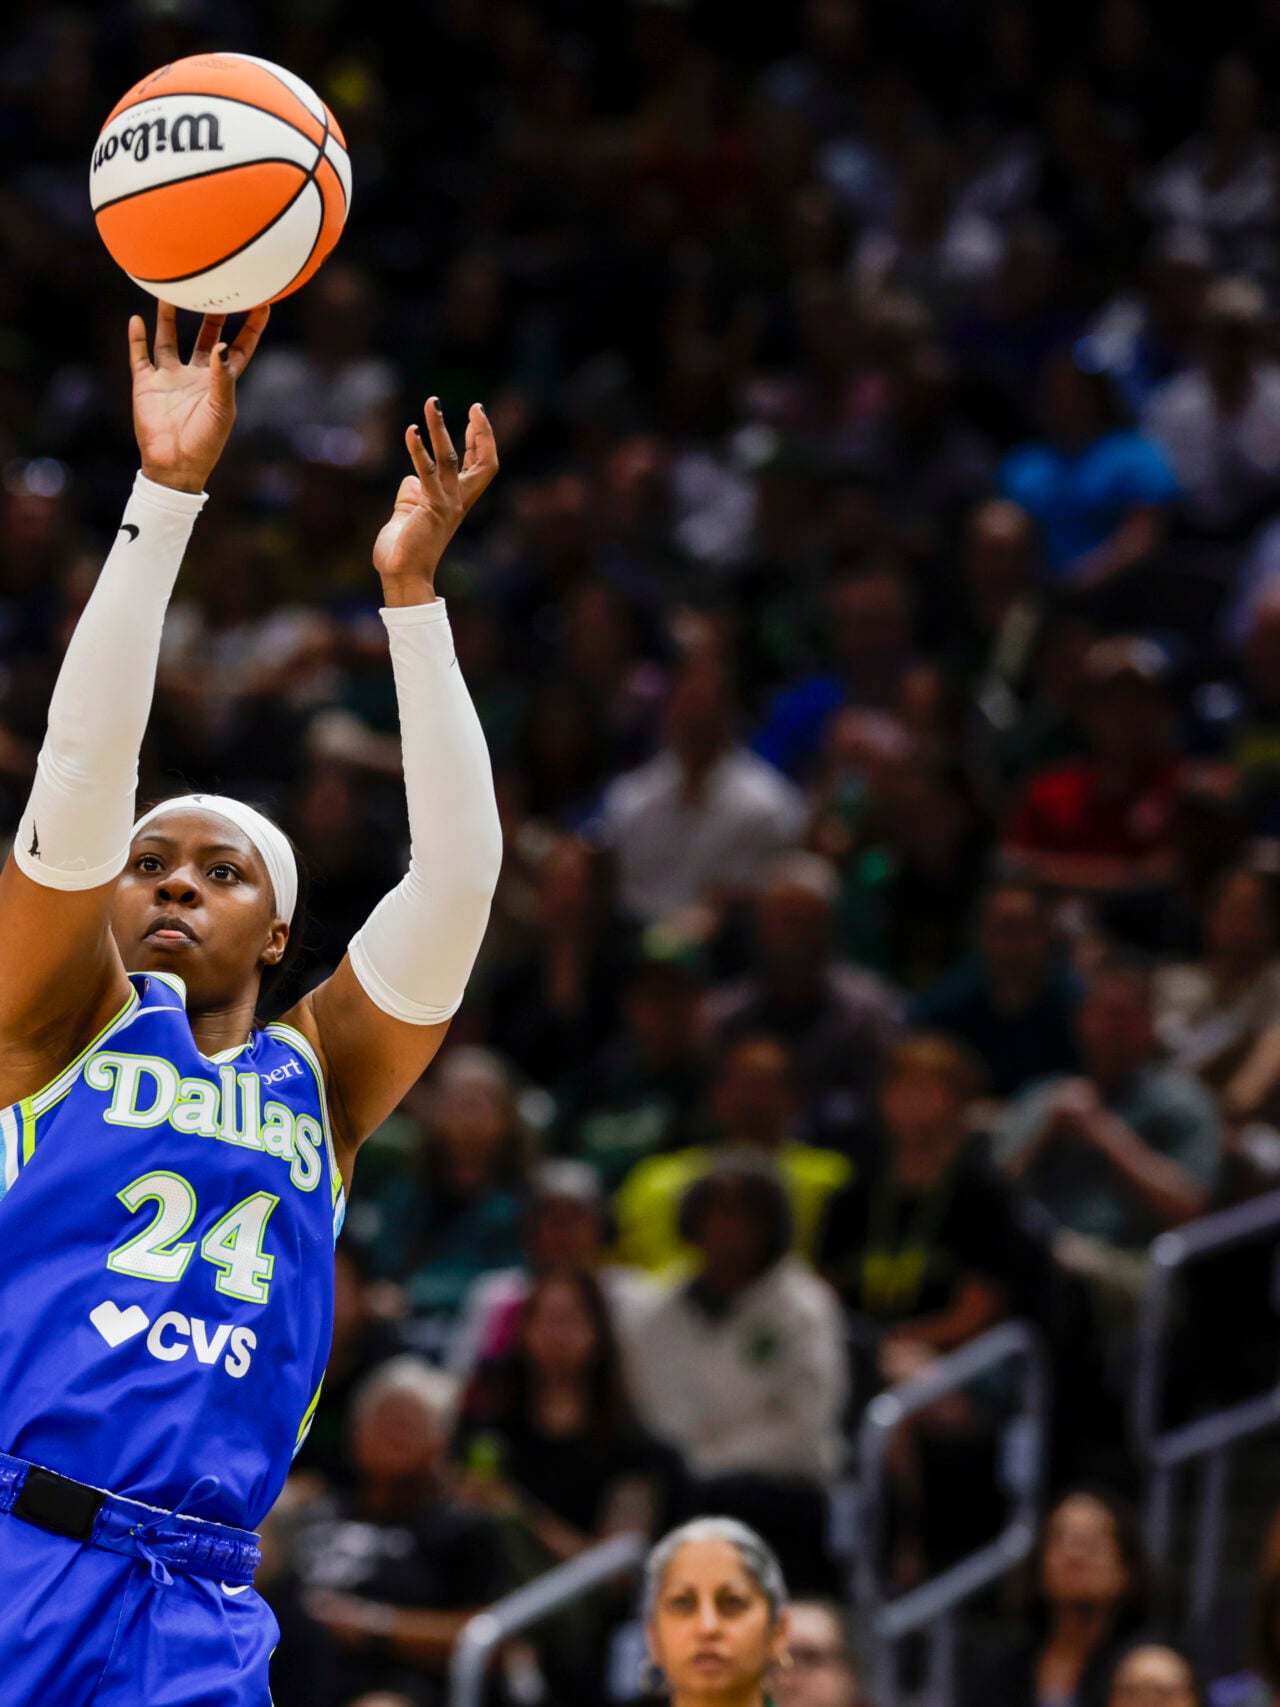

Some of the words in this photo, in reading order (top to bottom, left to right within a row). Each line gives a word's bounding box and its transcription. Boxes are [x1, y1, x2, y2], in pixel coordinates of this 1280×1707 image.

[84, 1051, 322, 1192] Dallas
[106, 1170, 280, 1304] 24
[147, 1311, 256, 1378] CVS
